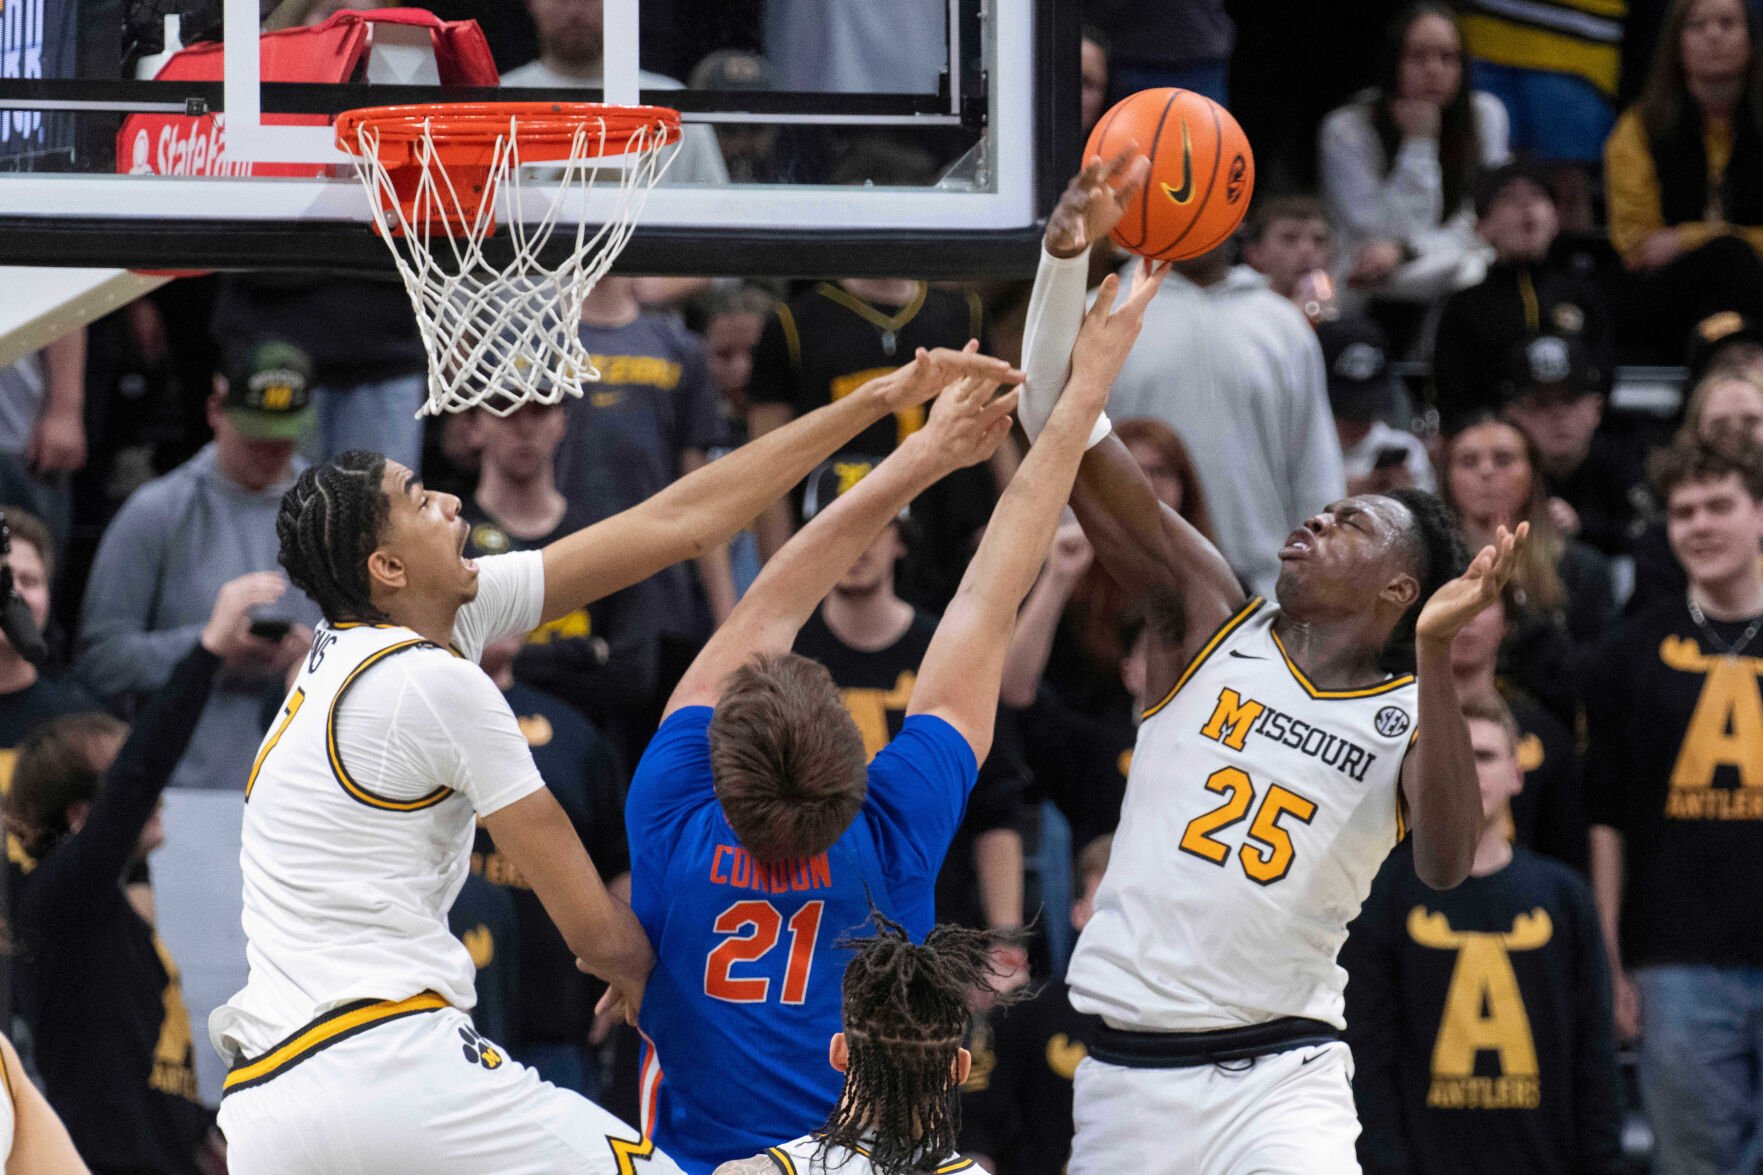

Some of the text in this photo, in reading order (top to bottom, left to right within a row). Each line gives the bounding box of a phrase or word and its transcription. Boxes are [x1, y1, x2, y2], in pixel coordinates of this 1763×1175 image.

[709, 843, 832, 894] CONDON
[1178, 765, 1319, 887] 25
[704, 900, 825, 1005] 21
